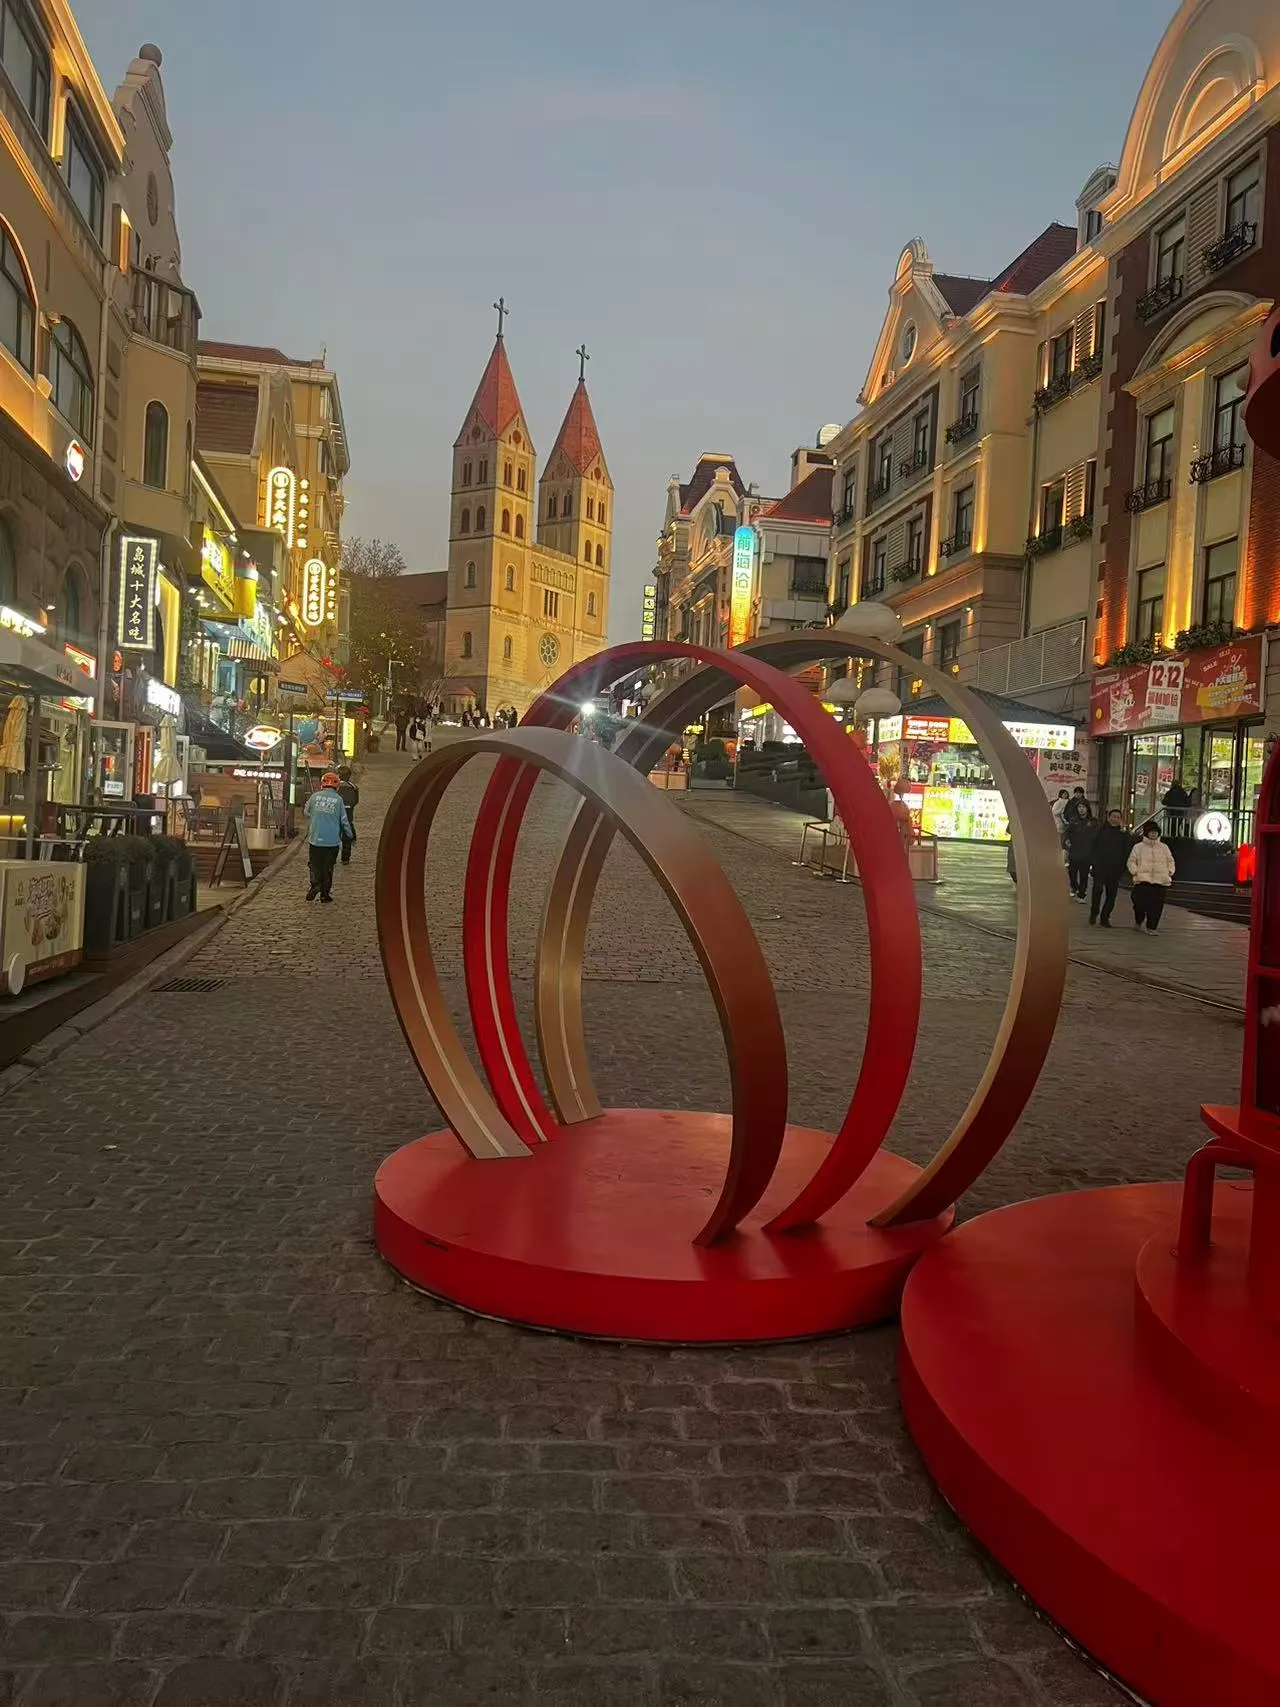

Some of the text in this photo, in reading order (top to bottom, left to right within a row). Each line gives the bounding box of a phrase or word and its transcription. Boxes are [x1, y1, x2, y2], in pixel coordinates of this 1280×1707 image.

[128, 546, 145, 641] 岛城十大名吃
[1202, 660, 1218, 673] SALE
